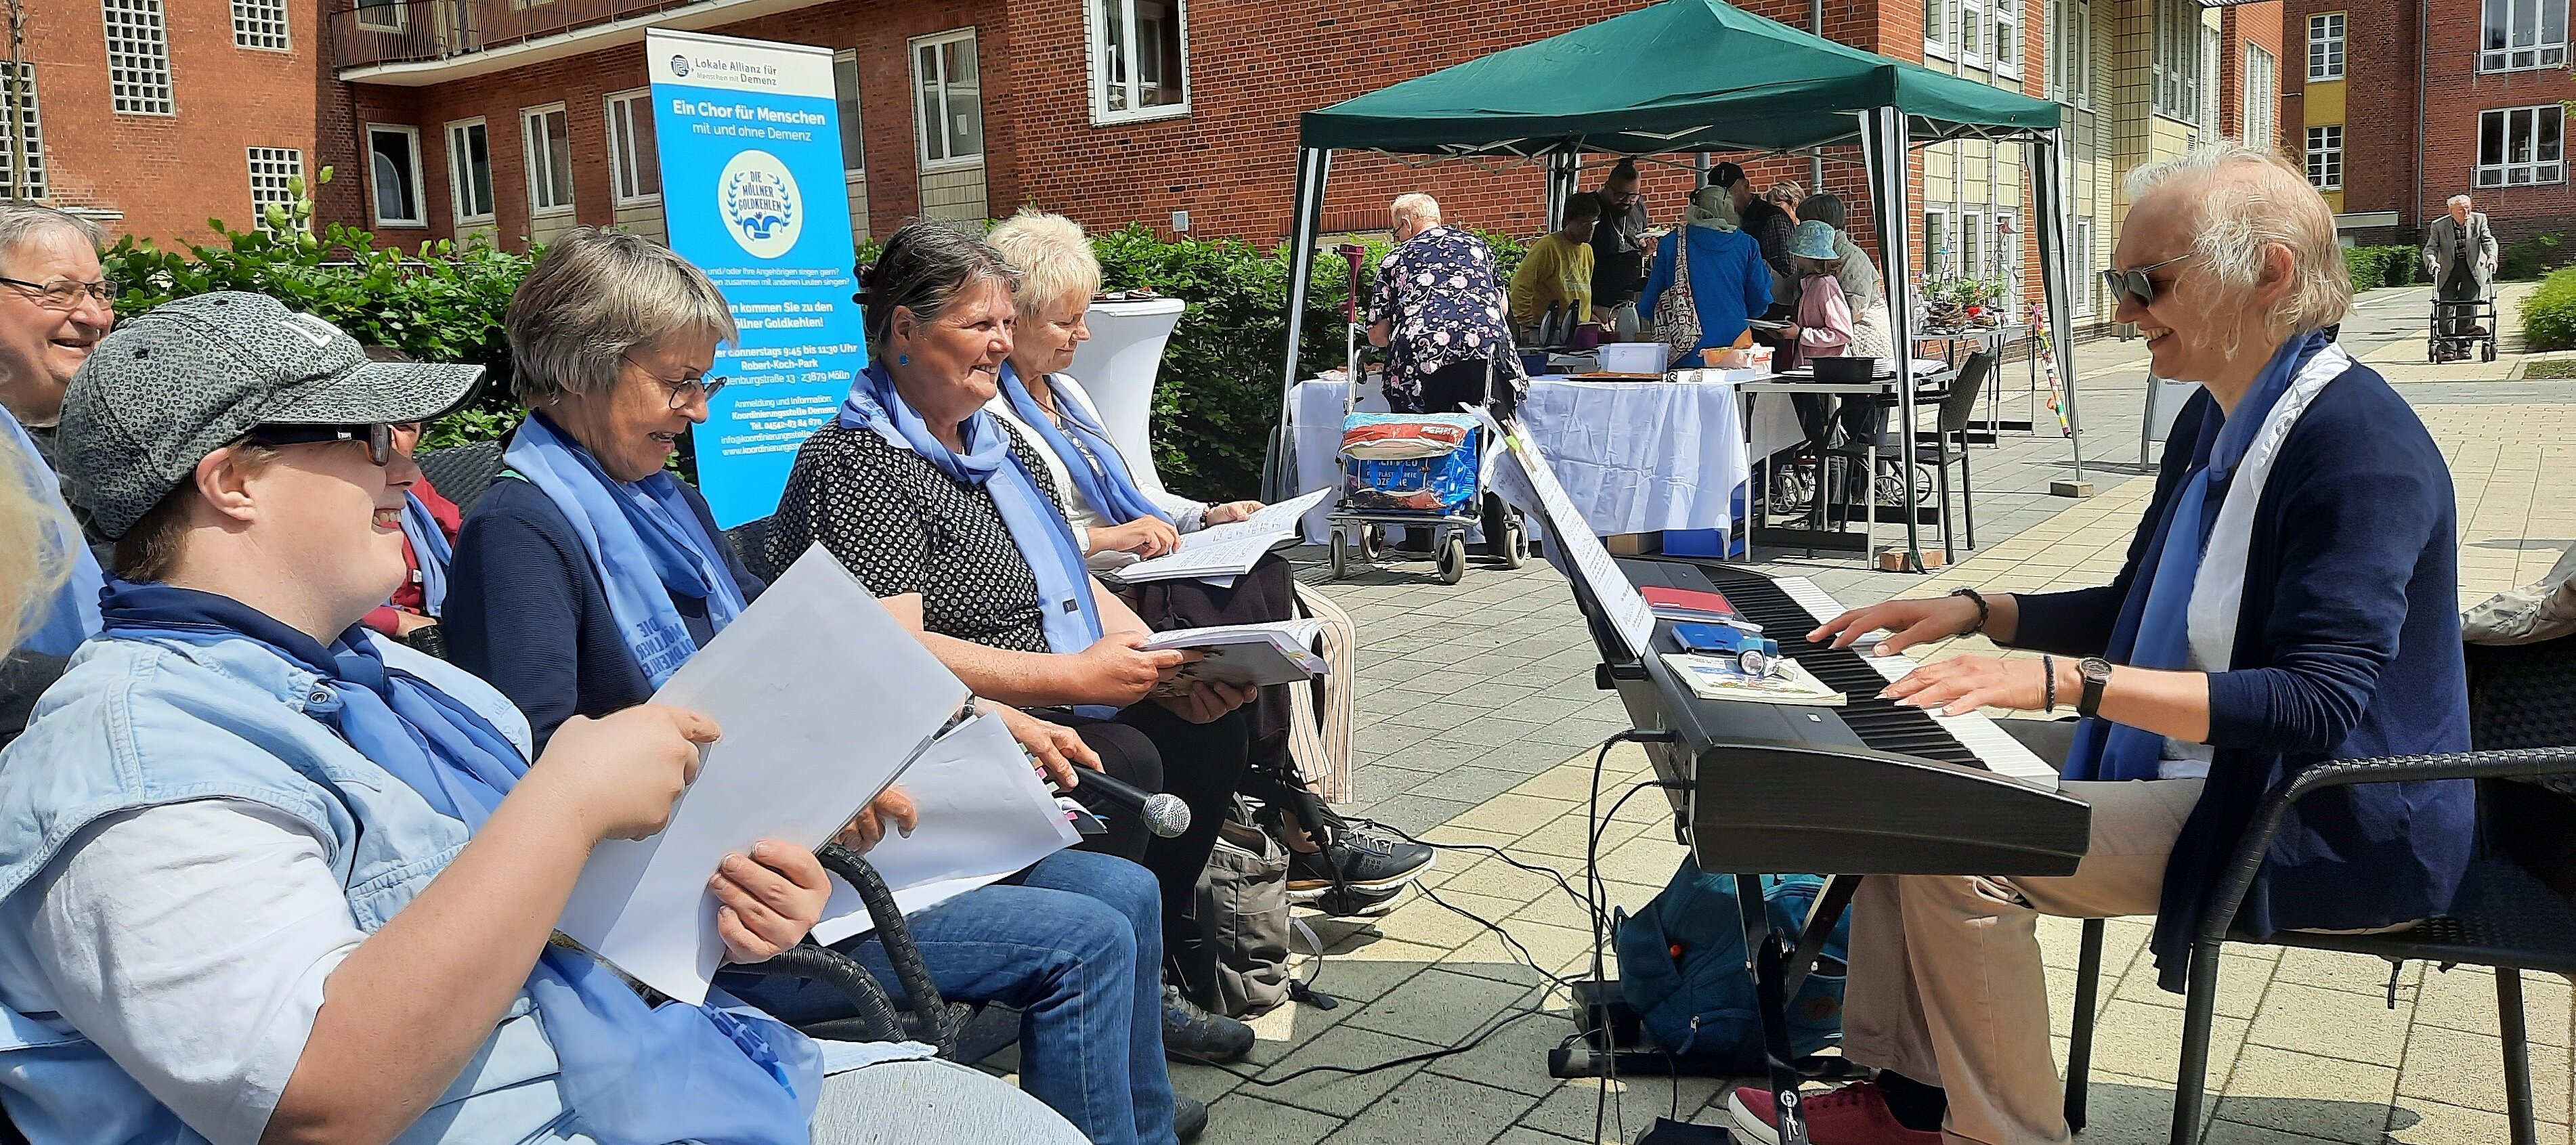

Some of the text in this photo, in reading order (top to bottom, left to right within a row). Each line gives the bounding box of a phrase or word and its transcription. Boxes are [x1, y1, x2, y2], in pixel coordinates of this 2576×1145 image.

[695, 58, 777, 75] Lokale Allianz für
[697, 72, 728, 81] Menschen
[741, 74, 777, 85] Demenz
[672, 100, 825, 125] Ein Chor für Menschen
[692, 122, 812, 142] mit und ohne Demenz
[750, 171, 762, 183] DIE
[742, 182, 774, 198] MÖLLNER
[738, 198, 782, 213] GOLDKEHLEN
[708, 267, 742, 276] und/oder
[743, 267, 755, 276] Ihre
[756, 267, 798, 278] Angehörigen
[798, 267, 819, 278] singen
[761, 278, 771, 286] mit
[773, 278, 800, 286] anderen
[801, 278, 822, 286] Leuten
[823, 277, 850, 287] singen?
[740, 301, 782, 314] kommen
[783, 301, 800, 313] Sie
[802, 303, 813, 312] zu
[815, 301, 833, 312] den
[735, 316, 824, 329] öllner Goldkehlen!
[802, 345, 817, 354] bis
[839, 343, 857, 353] Uhr
[741, 358, 819, 371] Robert-Koch-Park
[786, 374, 796, 384] 13
[801, 372, 826, 383] 23879
[828, 370, 850, 380] Mölln
[734, 398, 775, 408] Anmeldung
[776, 397, 790, 406] und
[731, 406, 838, 420] Koordinierungsstelle Demenz
